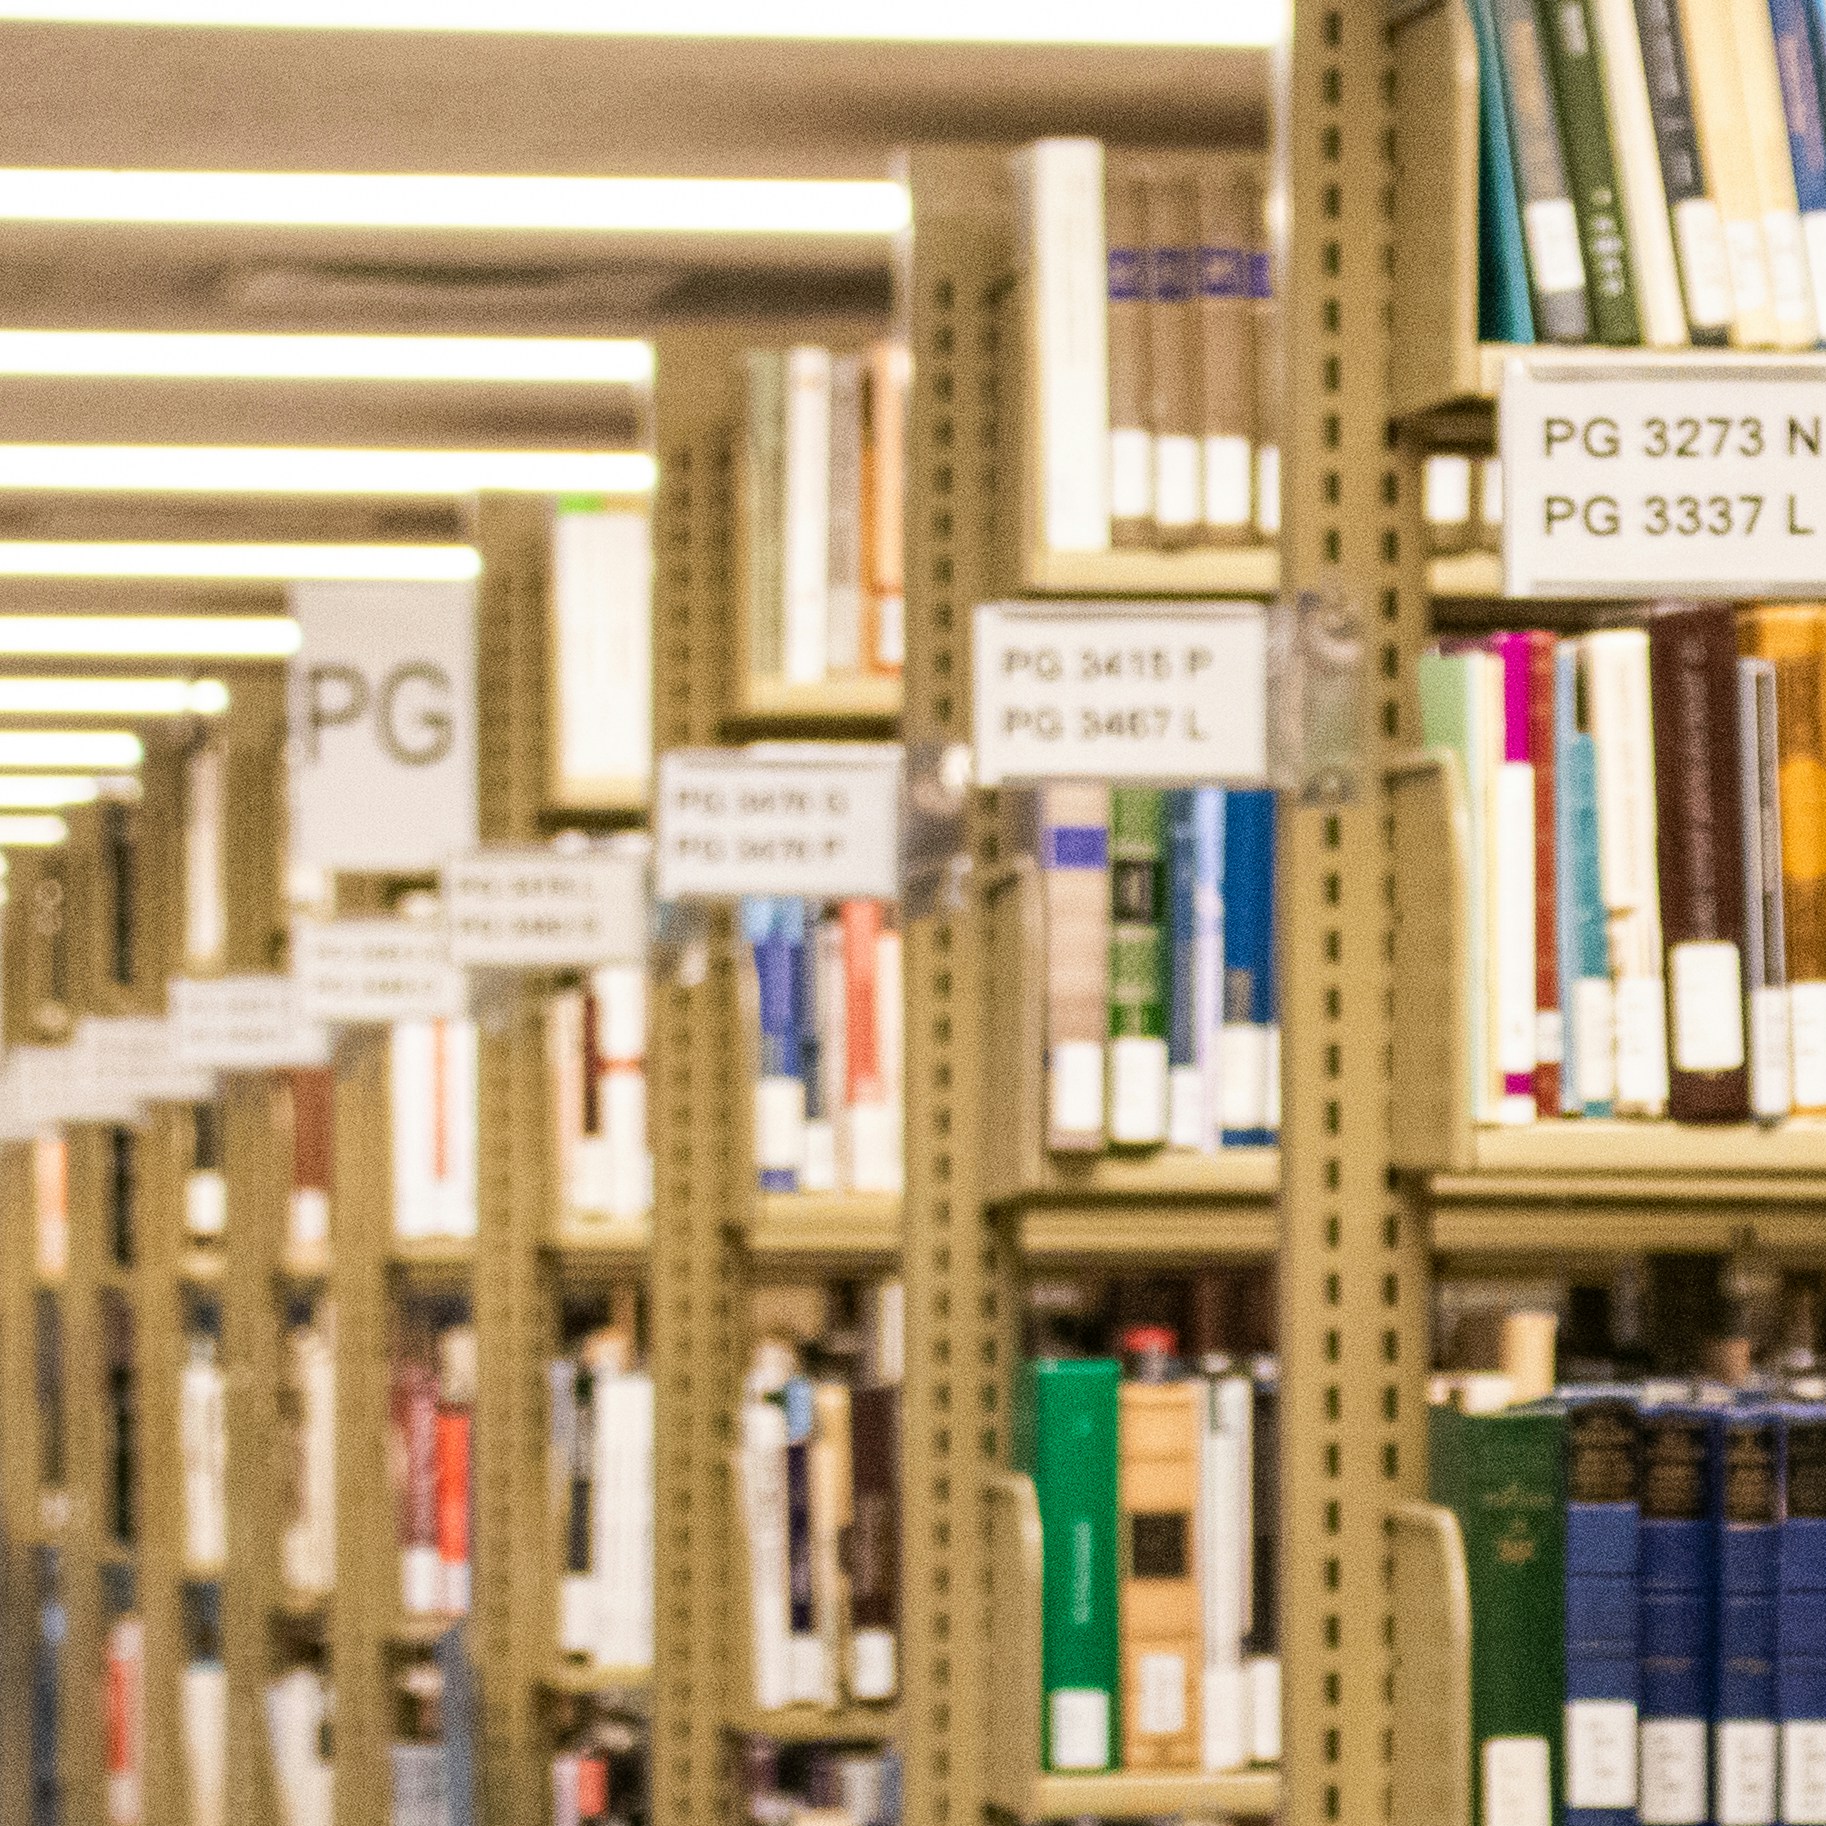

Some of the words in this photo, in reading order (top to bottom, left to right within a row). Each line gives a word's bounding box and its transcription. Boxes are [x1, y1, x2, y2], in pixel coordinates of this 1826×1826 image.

[1544, 418, 1620, 457] PG
[1643, 417, 1764, 457] 3273
[1787, 417, 1822, 457] N
[1544, 497, 1620, 537] PG
[1643, 496, 1763, 537] 3337
[1787, 497, 1815, 536] L
[1003, 648, 1062, 683] PG
[305, 660, 455, 767] PG
[1003, 706, 1062, 742] PG
